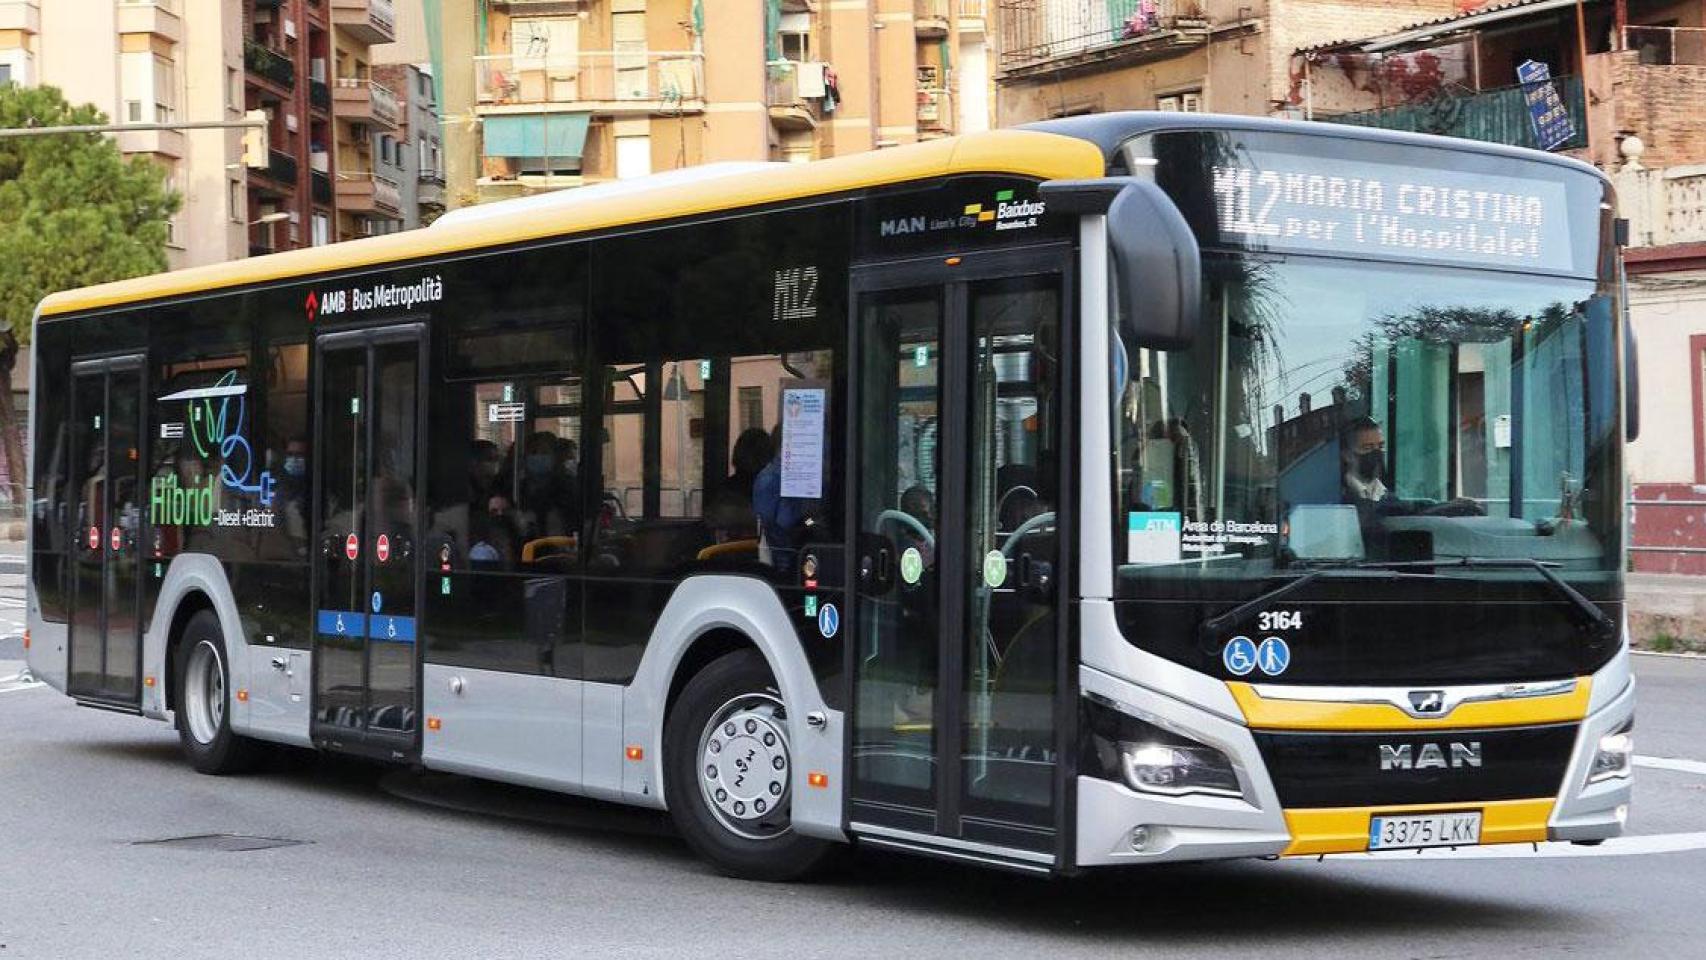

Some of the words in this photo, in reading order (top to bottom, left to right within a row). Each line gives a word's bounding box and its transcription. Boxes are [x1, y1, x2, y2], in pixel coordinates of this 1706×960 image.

[998, 200, 1046, 219] Baixbus
[1211, 166, 1281, 235] M12
[1285, 173, 1383, 211] MARIA
[1398, 184, 1542, 226] CRISTINA
[880, 216, 926, 237] MAN
[1285, 217, 1341, 241] per
[320, 290, 346, 315] AMB
[352, 288, 373, 311] Bus
[374, 275, 442, 309] Metropolità
[773, 266, 818, 320] M12
[151, 471, 213, 525] Híbrid
[1210, 520, 1225, 533] de
[1226, 520, 1278, 534] Barcelona
[1259, 611, 1302, 630] 3164
[1379, 741, 1483, 770] MAN
[1384, 820, 1434, 844] 3375
[1439, 817, 1477, 843] LKK
